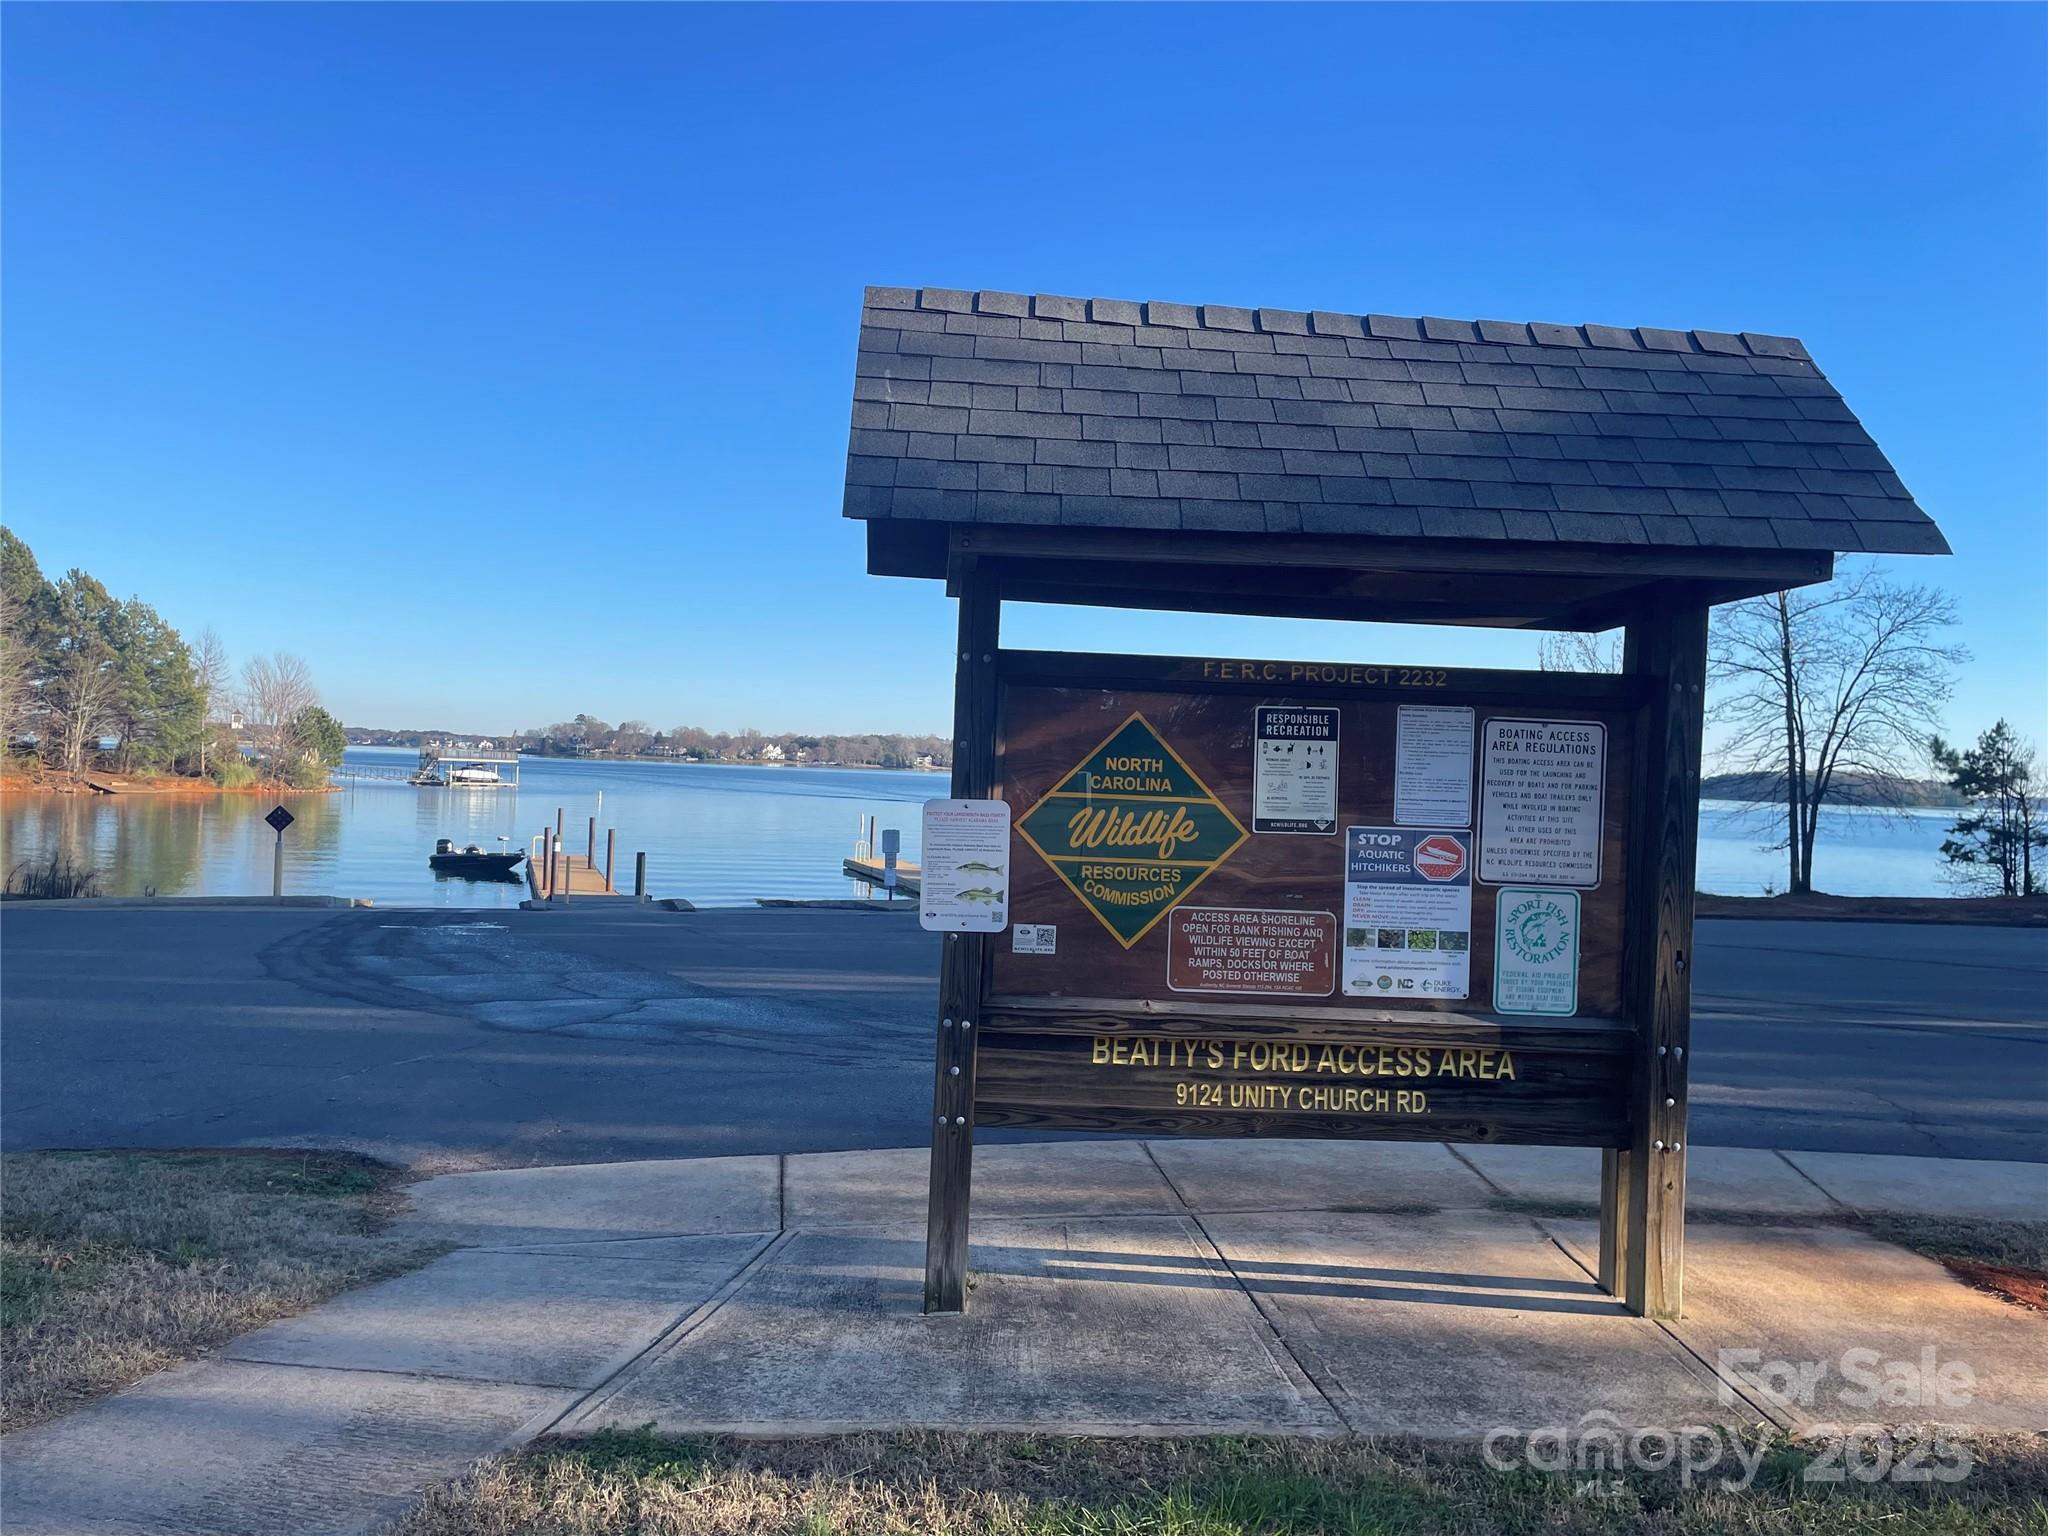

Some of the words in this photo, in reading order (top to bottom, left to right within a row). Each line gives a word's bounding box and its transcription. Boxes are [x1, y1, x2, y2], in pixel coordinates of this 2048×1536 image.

[1292, 666, 1392, 684] PROJECT
[1400, 670, 1447, 686] 2232
[1267, 714, 1329, 724] RESPONSIBLE
[1266, 725, 1328, 736] RECREATION
[1500, 729, 1543, 740] BOATING
[1550, 731, 1590, 742] ACCESS
[1492, 741, 1519, 751] AREA
[1526, 742, 1596, 755] REGULATIONS
[1106, 757, 1163, 772] NORTH
[1091, 776, 1172, 792] CAROLINA
[1068, 806, 1199, 859] Wildlife
[1358, 834, 1401, 846] STOP
[1358, 850, 1404, 860] AQUATIC
[1082, 865, 1181, 882] RESOURCES
[1351, 863, 1410, 873] HITCHIKERS
[1084, 879, 1175, 906] COMMISSION
[1191, 913, 1230, 923] ACCESS
[1232, 914, 1259, 923] AREA
[1261, 915, 1315, 925] SHORELINE
[1507, 900, 1543, 925] SPORT
[1546, 901, 1568, 926] FISH
[1183, 924, 1208, 933] OPEN
[1212, 925, 1230, 934] FOR
[1234, 926, 1260, 935] BANK
[1263, 927, 1300, 936] FISHING
[1303, 929, 1323, 937] AND
[1189, 935, 1233, 945] WILDLIFE
[1236, 937, 1276, 947] VIEWING
[1279, 939, 1315, 948] EXCEPT
[1505, 929, 1570, 964] RESTORATION
[1194, 947, 1227, 957] WITHIN
[1230, 948, 1240, 957] 50
[1242, 949, 1266, 958] FEET
[1269, 950, 1281, 958] OF
[1285, 951, 1310, 960] BOAT
[1188, 958, 1224, 969] RAMPS,
[1228, 960, 1261, 969] DOCKS
[1264, 961, 1277, 970] OR
[1280, 961, 1314, 972] WHERE
[1203, 970, 1240, 980] POSTED
[1244, 971, 1300, 982] OTHERWISE
[1092, 1038, 1224, 1069] BEATTY'S
[1234, 1040, 1310, 1072] FORD
[1317, 1043, 1432, 1076] ACCESS
[1438, 1048, 1516, 1080] AREA
[1176, 1083, 1223, 1106] 9124
[1230, 1084, 1292, 1109] UNITY
[1299, 1087, 1389, 1113] CHURCH
[1397, 1090, 1431, 1114] RD.
